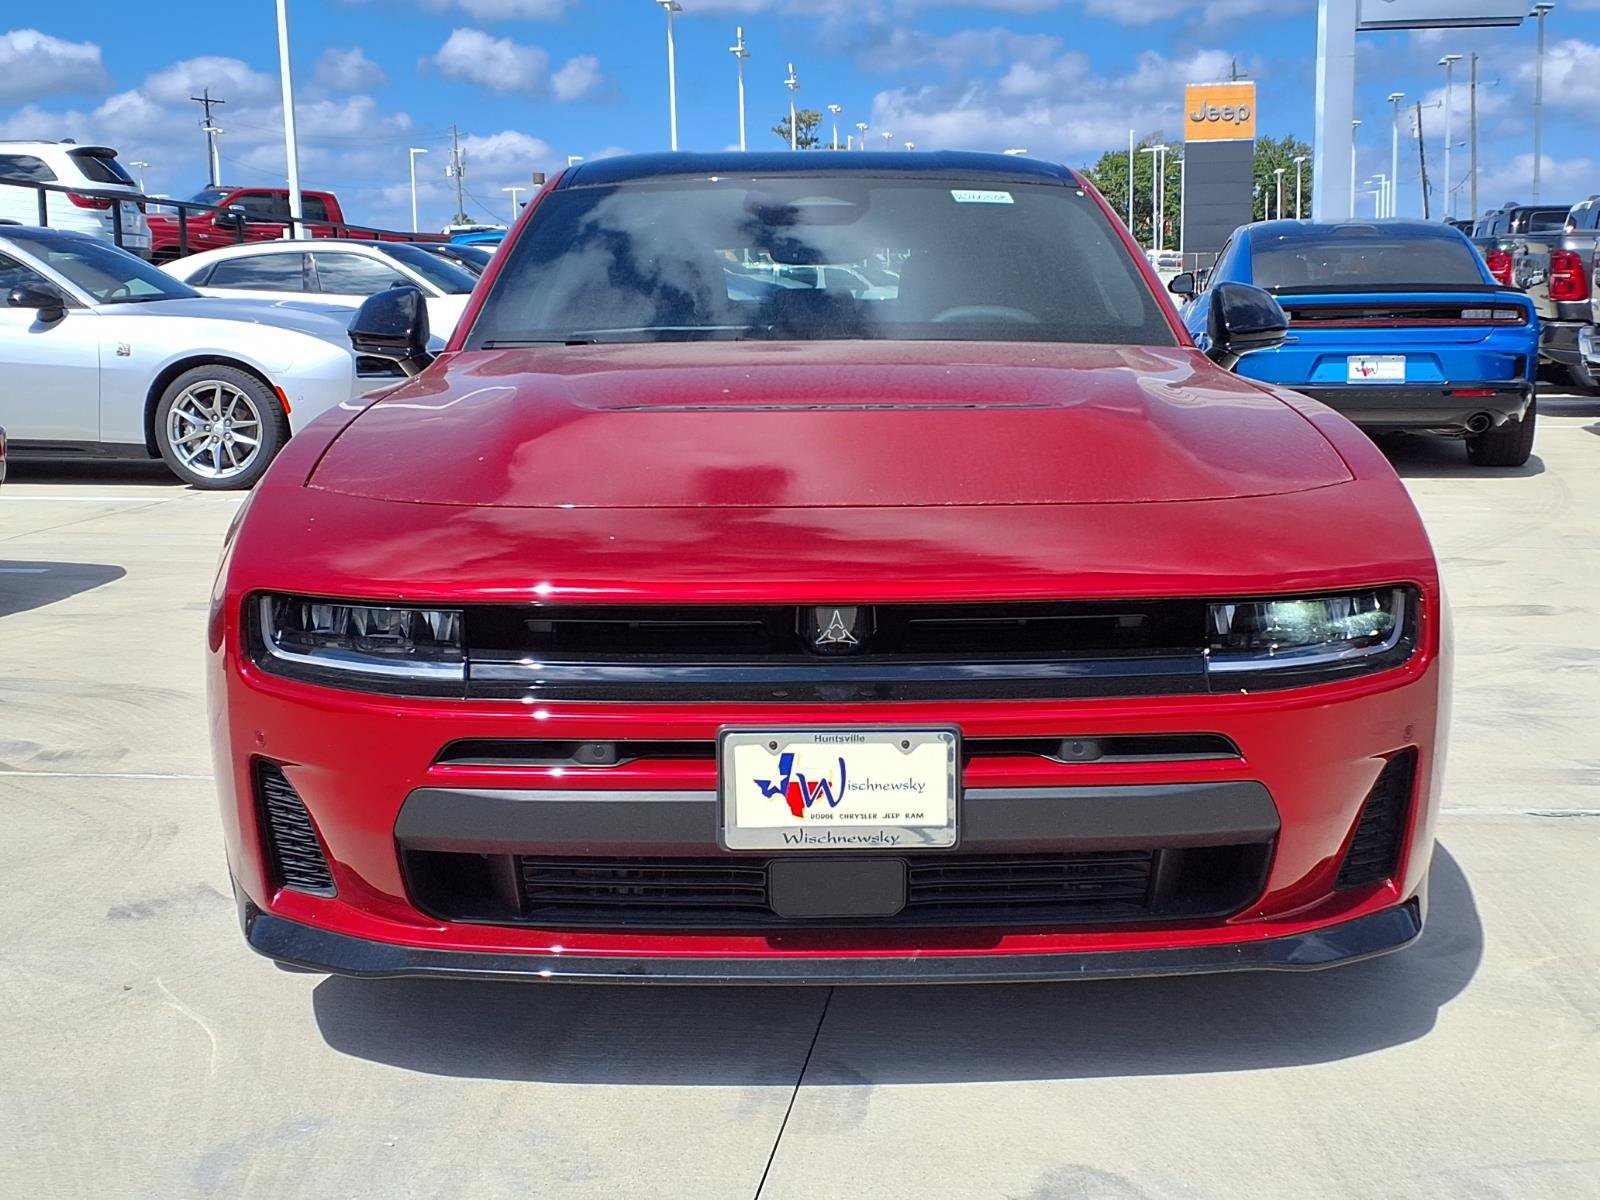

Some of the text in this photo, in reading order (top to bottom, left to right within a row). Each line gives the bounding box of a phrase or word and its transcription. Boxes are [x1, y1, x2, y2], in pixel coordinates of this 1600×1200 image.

[1190, 100, 1250, 125] Jeep
[814, 734, 865, 743] Huntsville
[795, 756, 926, 808] Wischnewsky
[782, 828, 900, 845] Wischnewsky
